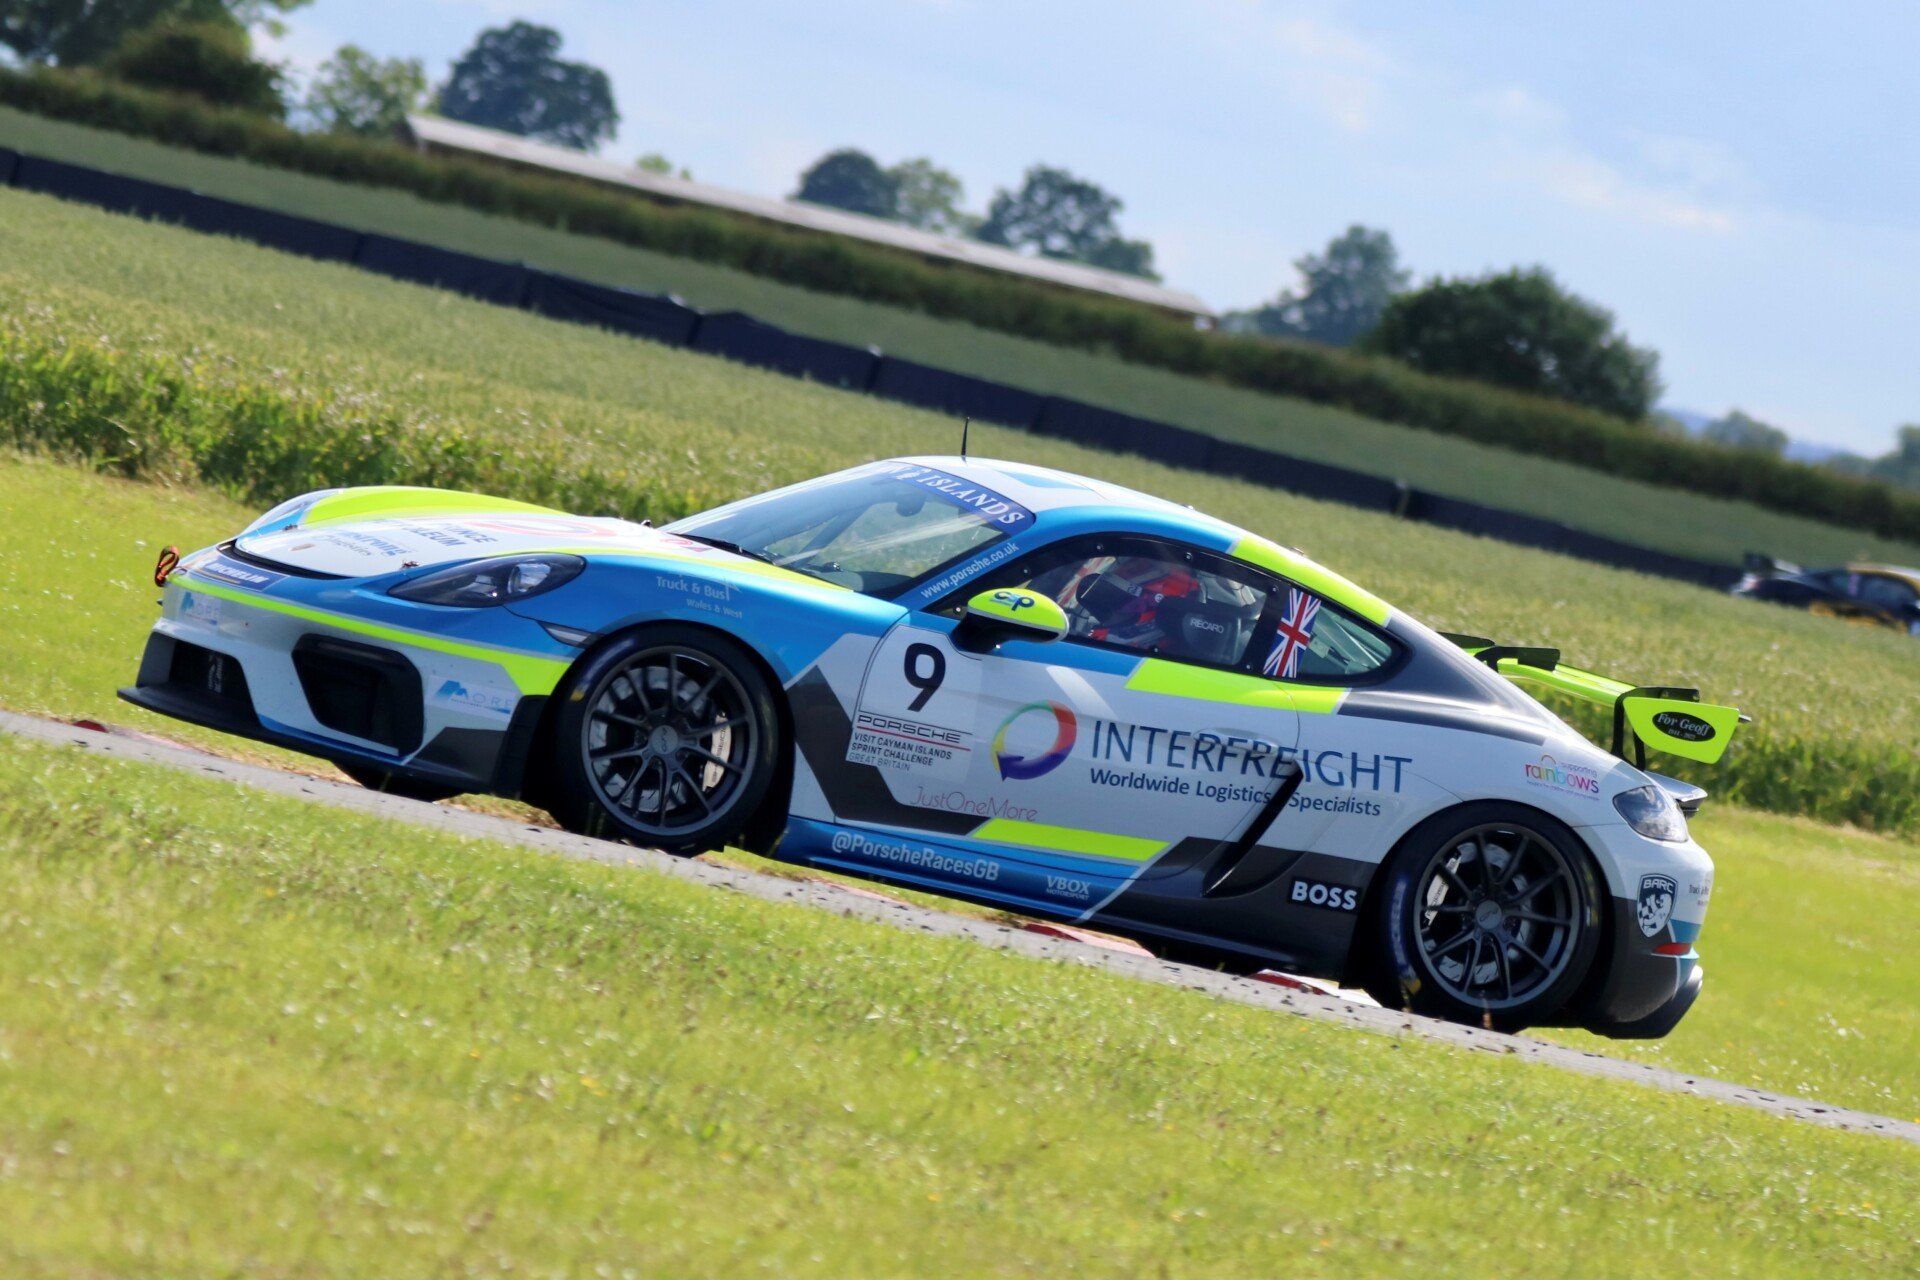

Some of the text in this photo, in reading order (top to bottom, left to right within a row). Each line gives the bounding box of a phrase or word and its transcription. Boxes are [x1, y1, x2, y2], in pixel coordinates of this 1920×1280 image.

[916, 475, 1025, 524] ISLANDS
[921, 542, 1020, 598] www.porsche.co.uk
[656, 575, 689, 592] Truck
[692, 583, 700, 594] &
[686, 598, 712, 611] Wales
[723, 606, 743, 619] West
[1190, 618, 1224, 634] RECARO
[904, 643, 946, 712] 9
[858, 714, 962, 743] PORSCHE
[1657, 713, 1677, 726] For
[1679, 718, 1710, 736] Geoff
[851, 742, 933, 766] SPRINT CHALLENGE
[854, 732, 952, 759] VISIT CAYMAN ISLANDS
[1092, 720, 1413, 793] INTERFREIGHT
[849, 752, 910, 771] GREAT BRITAIN
[1090, 768, 1381, 816] Worldwide Logistics Specialists
[1525, 764, 1599, 793] rainbows
[910, 786, 1038, 822] JustOneMore
[831, 831, 1000, 881] @PorscheRacesGB
[1046, 888, 1089, 900] MOTORSPORT
[1047, 875, 1090, 894] VBOX
[1292, 880, 1357, 910] BOSS
[1643, 879, 1674, 894] BARC
